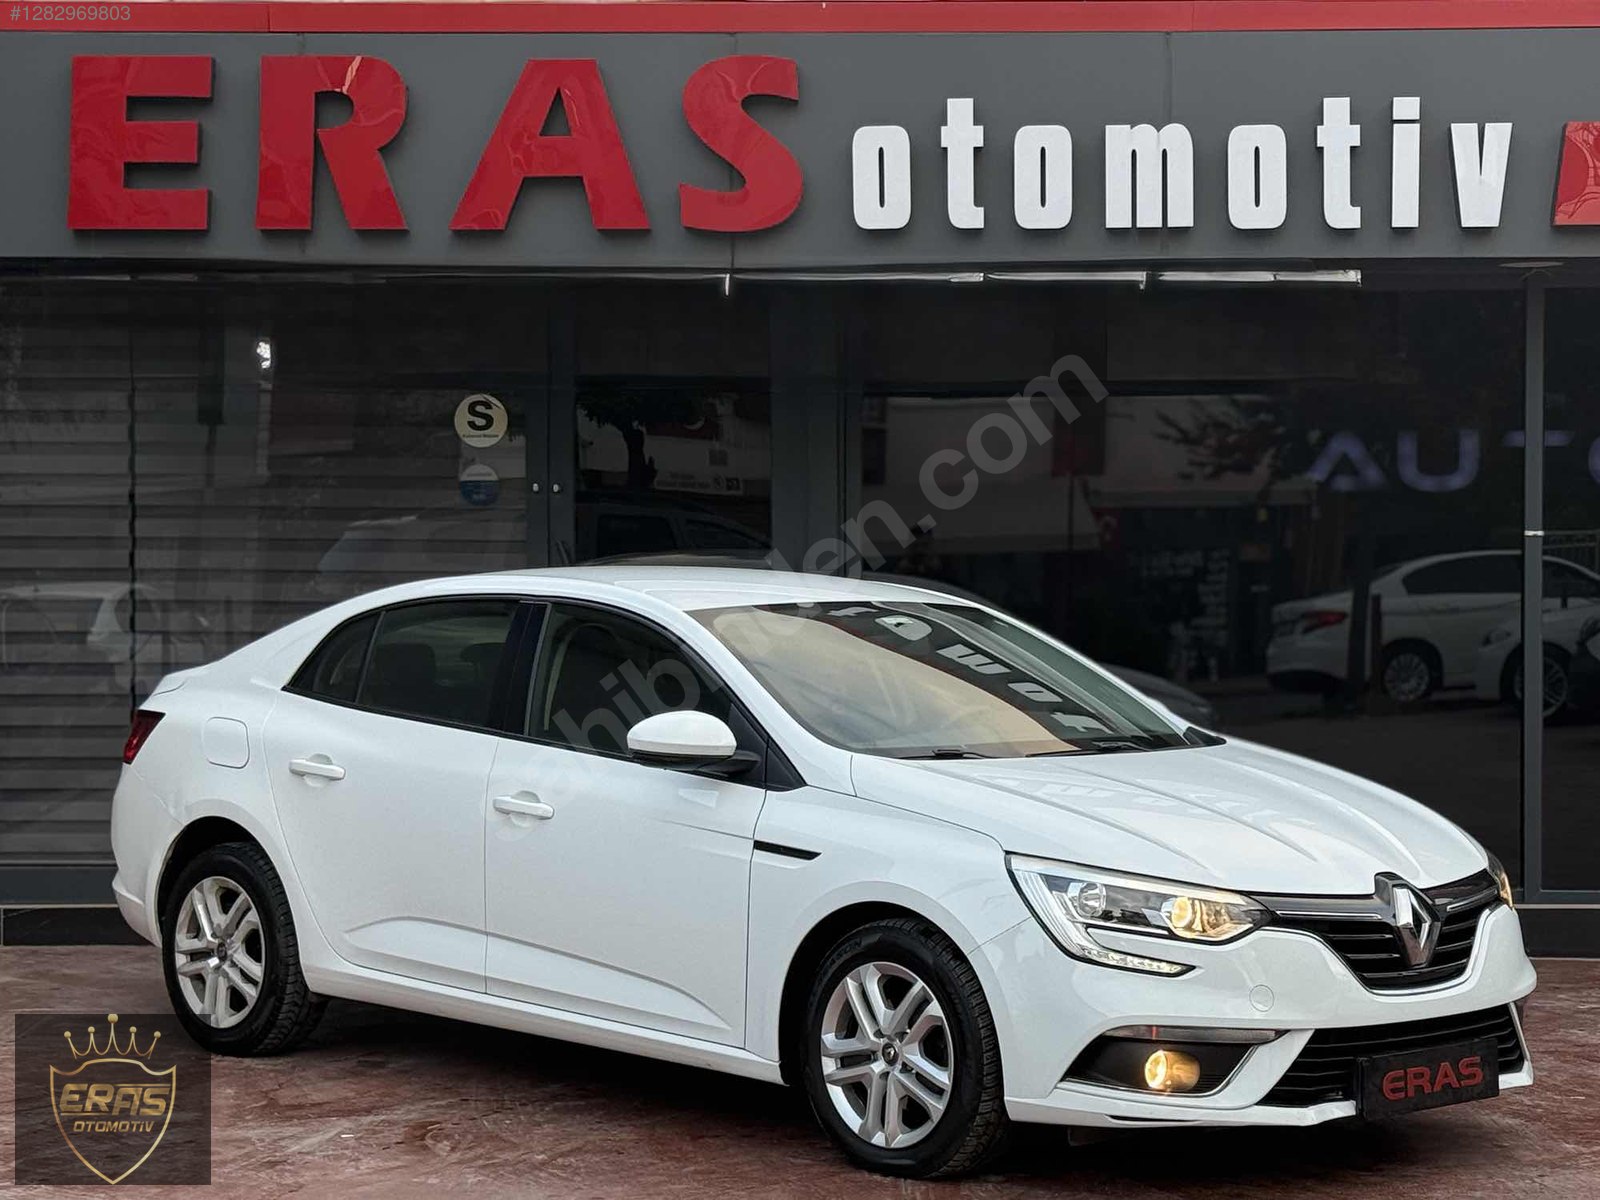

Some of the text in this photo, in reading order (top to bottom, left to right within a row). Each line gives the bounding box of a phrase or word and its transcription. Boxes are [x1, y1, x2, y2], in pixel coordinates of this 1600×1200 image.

[68, 55, 1512, 232] ERAS otomotiv
[467, 400, 494, 431] S
[1382, 1056, 1484, 1100] ERAS
